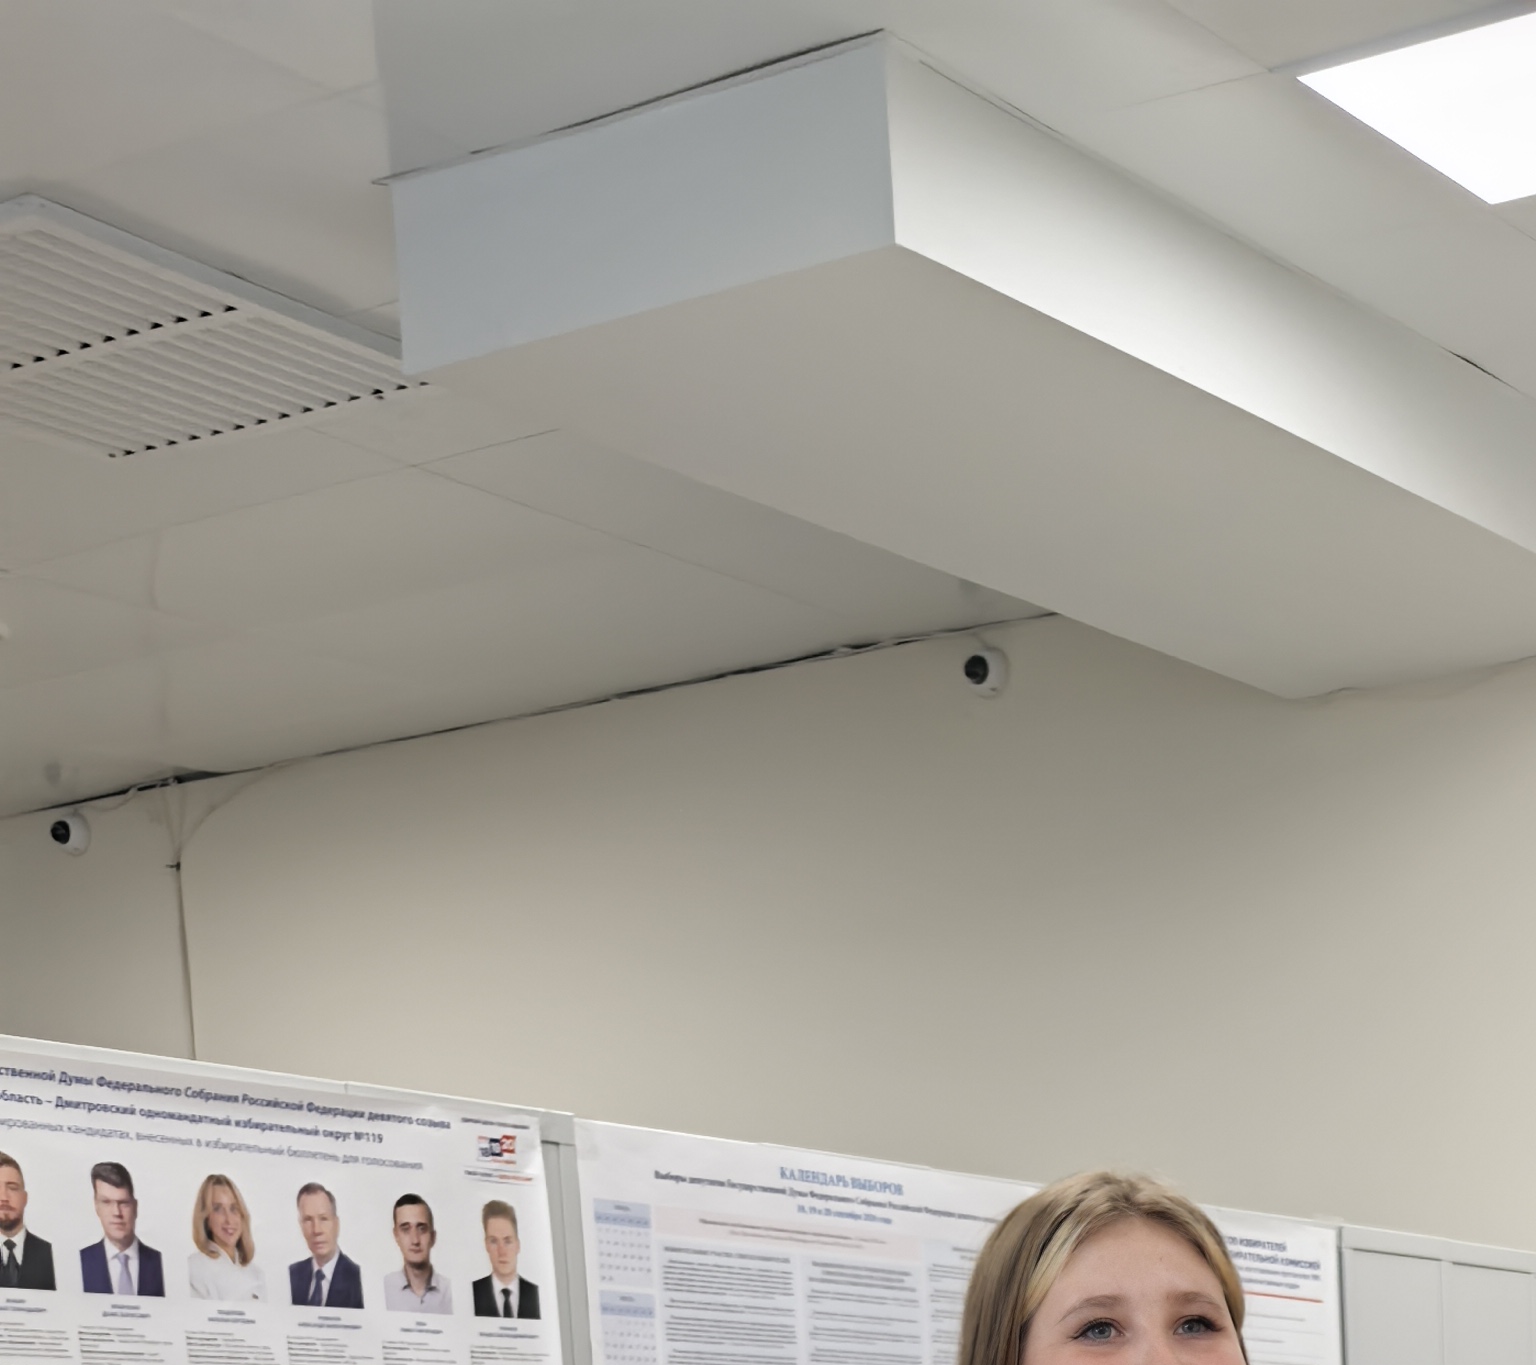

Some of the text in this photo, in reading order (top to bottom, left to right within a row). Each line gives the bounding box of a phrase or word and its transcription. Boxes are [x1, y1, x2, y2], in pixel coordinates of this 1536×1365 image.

[59, 1071, 93, 1086] Думы
[96, 1076, 181, 1096] Федерального
[184, 1086, 239, 1102] Собрания
[242, 1093, 303, 1112] Российской
[306, 1102, 364, 1119] Федерации
[55, 1096, 136, 1116] Дмитровский
[139, 1108, 231, 1127] одномандатный
[234, 1118, 320, 1137] избирательный
[323, 1129, 351, 1142] округ
[780, 1166, 904, 1196] КАЛЕНДАРЬ ВЫБОРОВ
